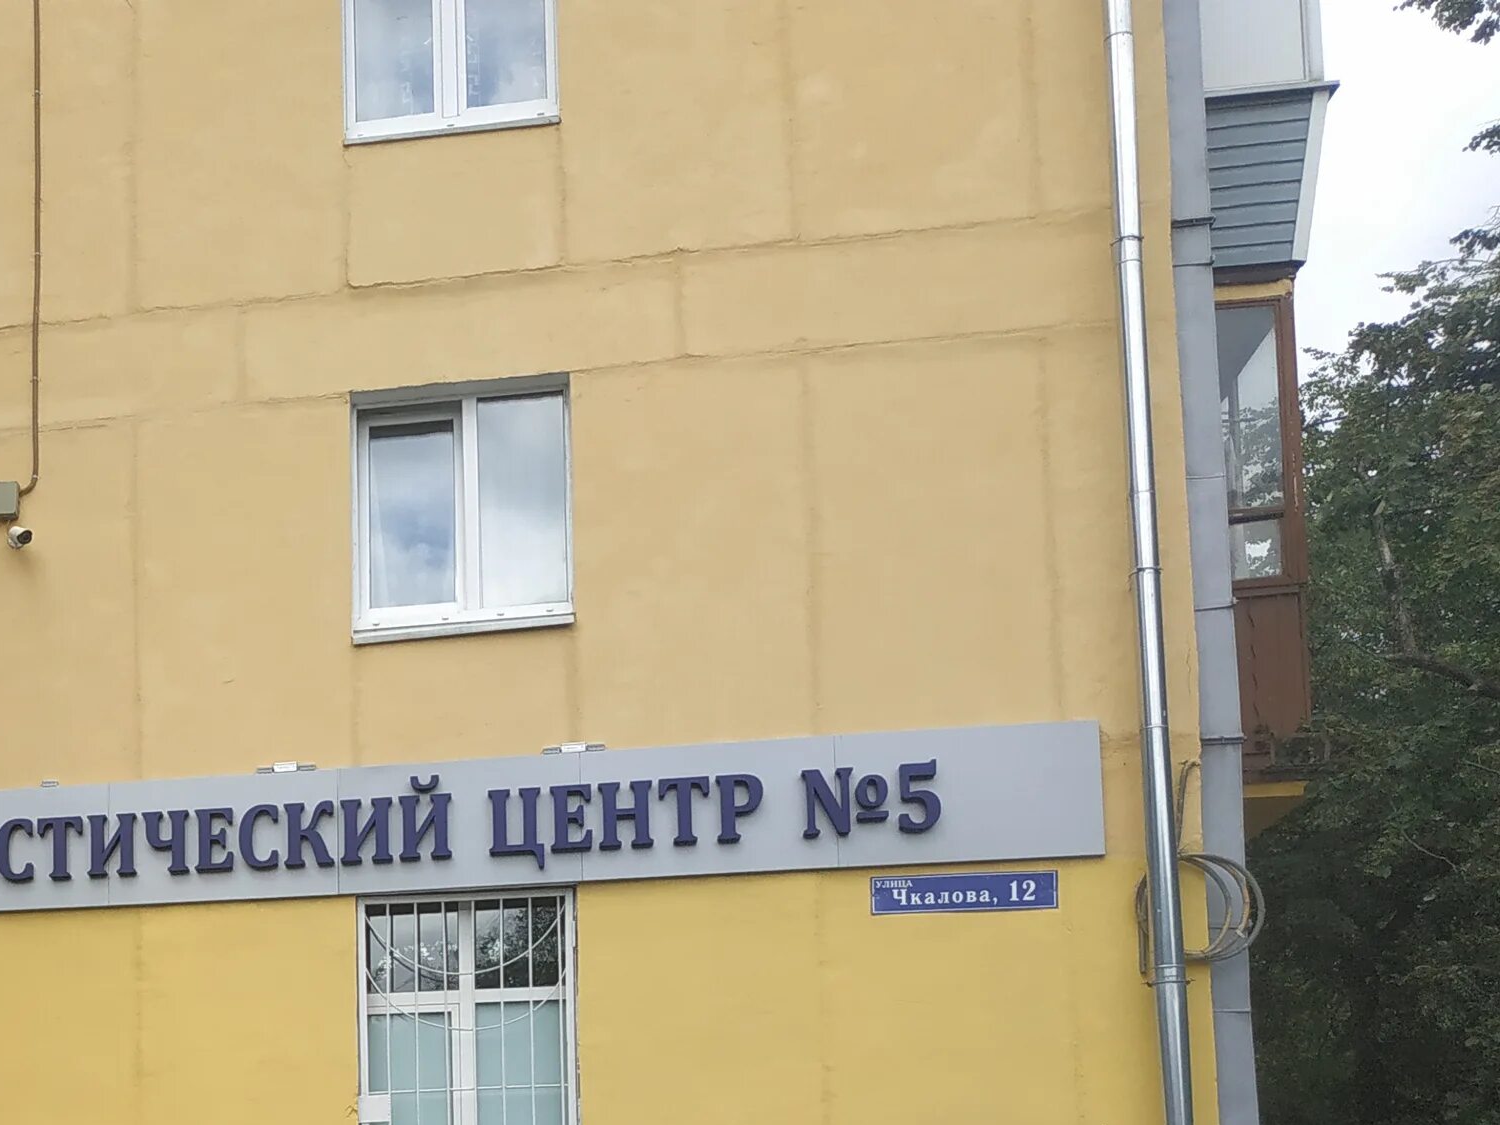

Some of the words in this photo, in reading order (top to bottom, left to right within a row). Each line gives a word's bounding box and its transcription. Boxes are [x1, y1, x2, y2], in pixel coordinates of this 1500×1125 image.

[487, 774, 763, 869] ЦЕНТР
[800, 758, 942, 839] №5
[892, 888, 998, 906] Чкалова,
[1009, 879, 1036, 901] 12
